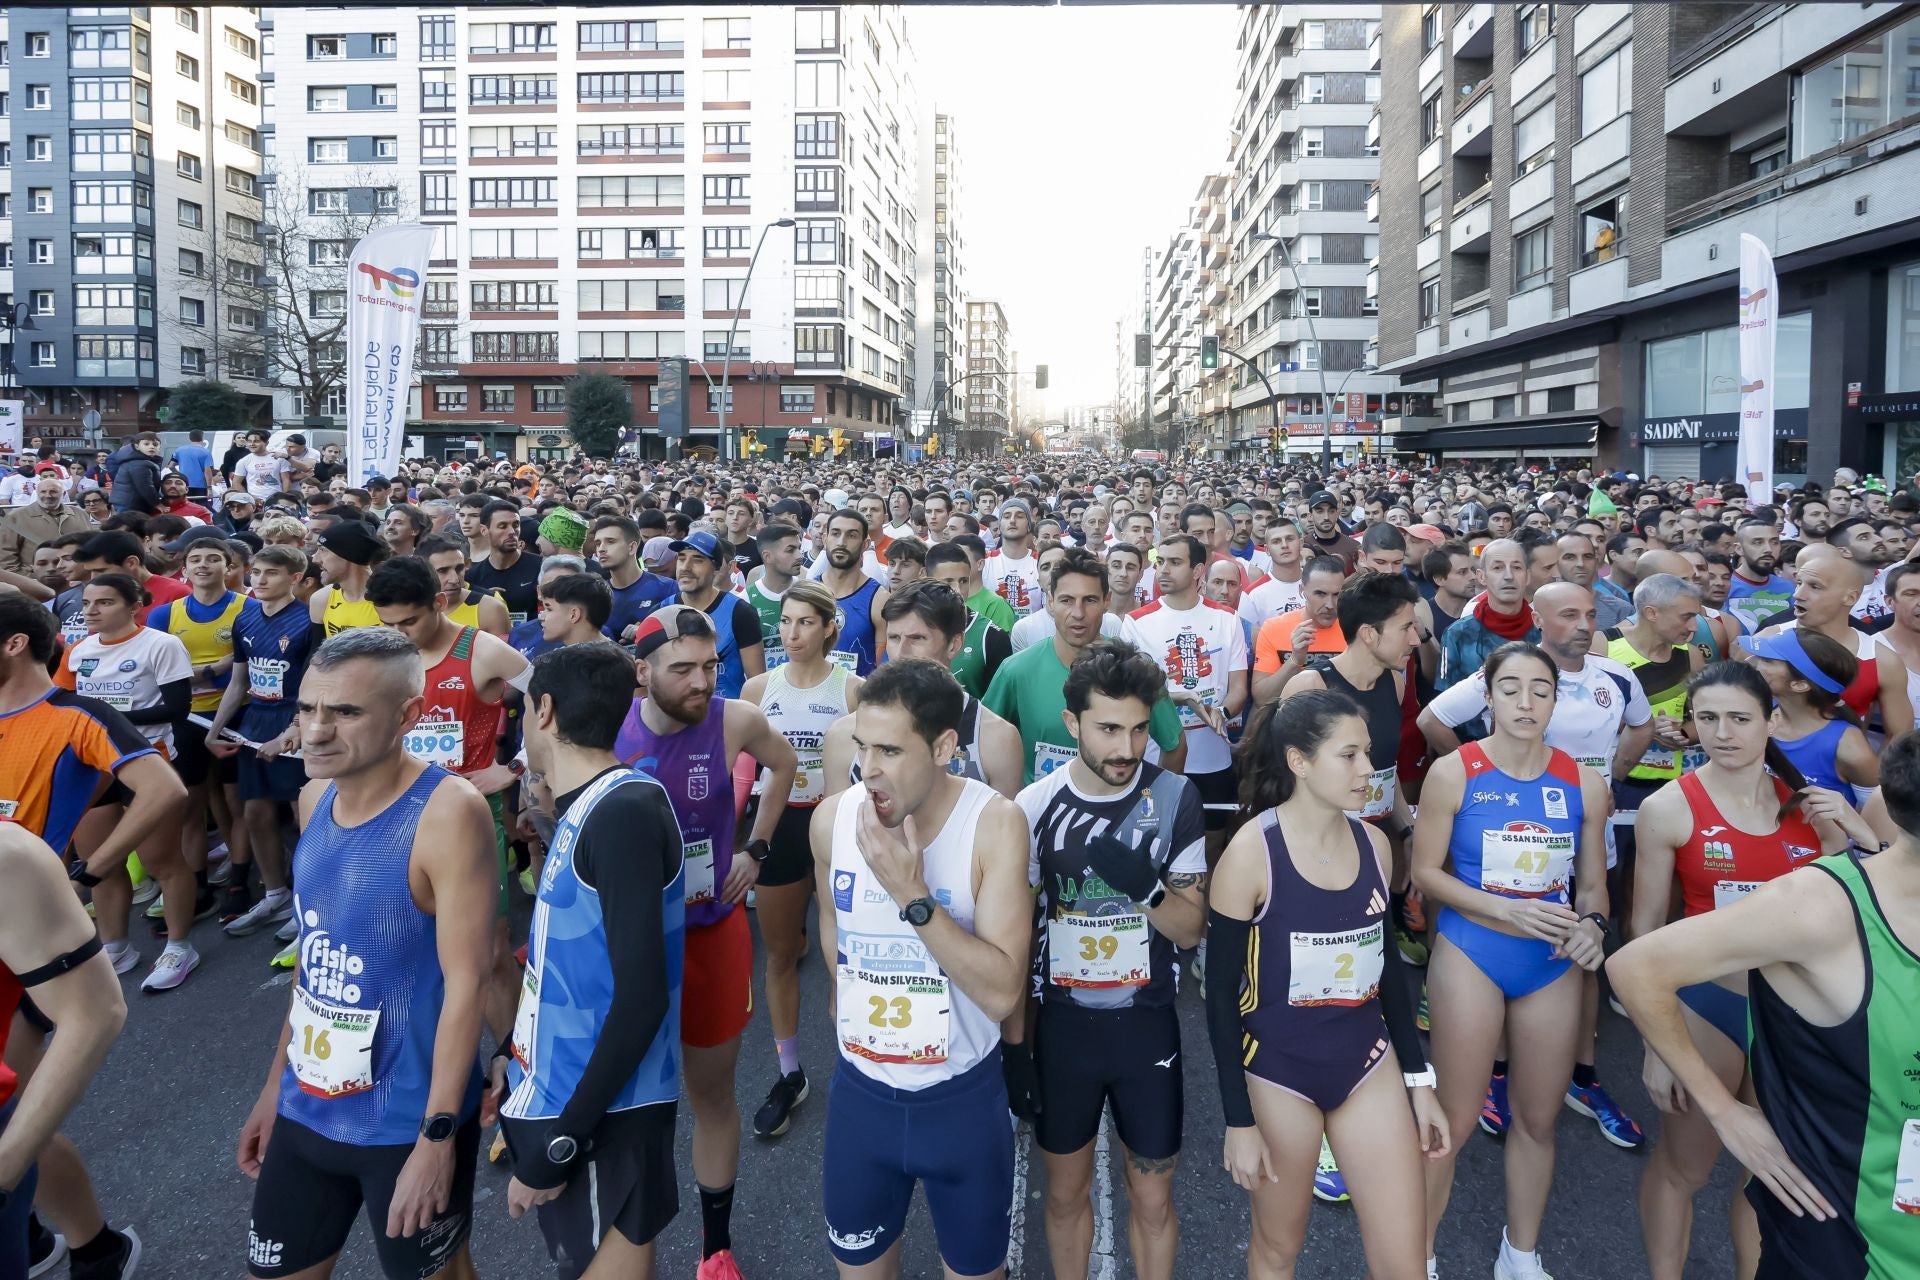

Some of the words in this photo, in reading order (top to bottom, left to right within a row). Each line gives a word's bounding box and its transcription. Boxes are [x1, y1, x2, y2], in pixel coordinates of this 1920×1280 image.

[357, 294, 416, 313] TotalEnergies
[1644, 418, 1703, 440] SADENT
[1185, 634, 1197, 642] 55
[1179, 641, 1197, 649] SAN
[1180, 649, 1197, 657] SIL
[1181, 658, 1198, 667] VES
[1181, 667, 1199, 678] TRE
[84, 681, 135, 692] OVIEDO
[797, 737, 819, 748] TRI
[1057, 748, 1071, 756] SAN
[1501, 834, 1513, 842] 55
[1513, 835, 1531, 843] SAN
[1532, 836, 1572, 844] SILVESTRE
[1514, 850, 1551, 874] 47
[1703, 860, 1736, 869] Asturias
[1737, 884, 1751, 893] 55
[1067, 917, 1079, 926] 55
[1079, 918, 1097, 928] SAN
[1097, 915, 1143, 928] SILVESTRE
[1312, 937, 1325, 946] 55
[1325, 936, 1344, 946] SAN
[1344, 926, 1381, 944] SILVESTRE
[1078, 935, 1119, 961] 39
[871, 959, 915, 970] deporte
[1334, 953, 1354, 979] 2
[857, 970, 869, 982] 55
[868, 973, 889, 986] SAN
[890, 975, 943, 988] SILVESTRE
[927, 987, 943, 995] 2024
[309, 999, 320, 1016] SAN
[319, 1006, 373, 1024] SILVESTRE
[867, 994, 913, 1029] 23
[351, 1023, 369, 1032] 2024
[303, 1024, 332, 1061] 16
